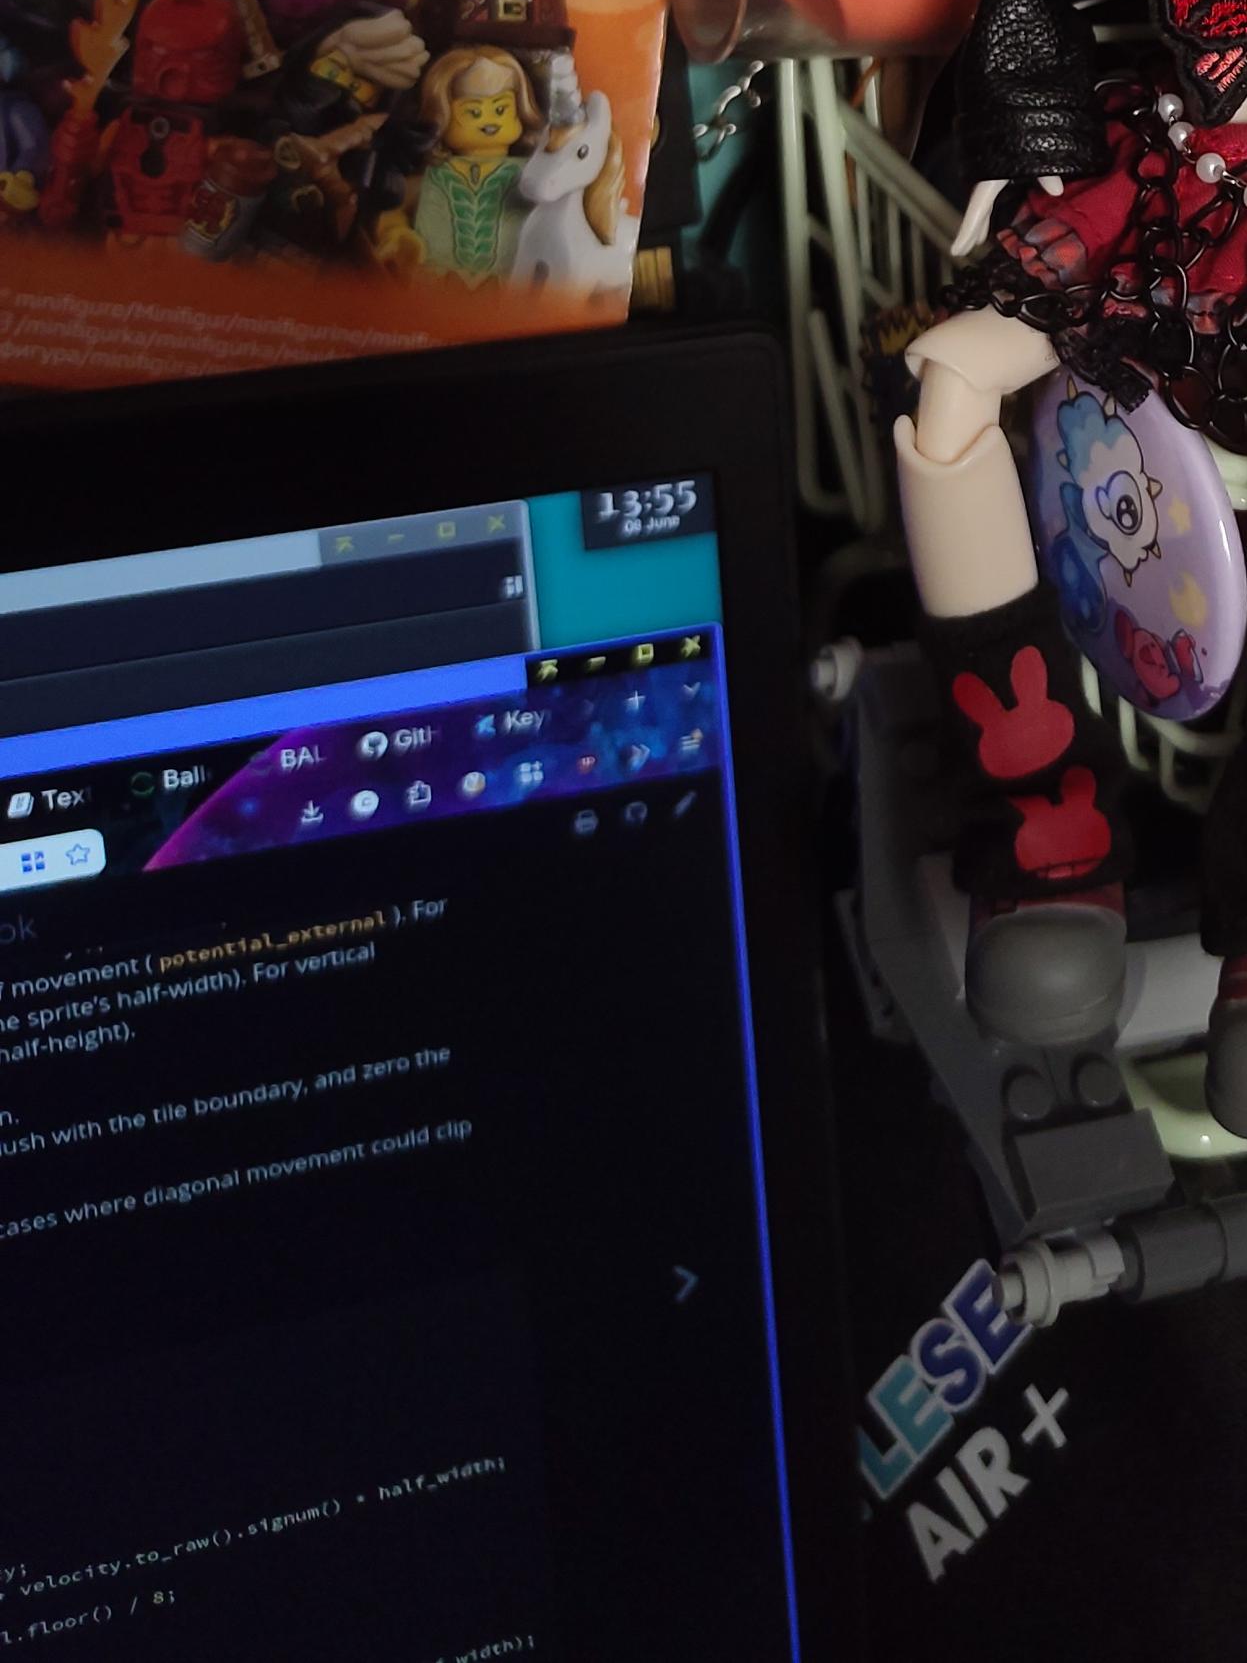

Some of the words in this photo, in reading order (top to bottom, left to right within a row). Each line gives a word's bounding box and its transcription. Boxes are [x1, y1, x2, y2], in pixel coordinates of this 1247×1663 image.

[598, 480, 697, 522] 13:55
[12, 958, 140, 998] movement
[411, 898, 448, 920] For
[27, 995, 111, 1030] sprite's
[252, 961, 288, 984] For
[294, 942, 377, 974] vertical
[51, 1120, 102, 1146] with
[108, 1112, 147, 1135] the
[152, 1103, 188, 1125] tile
[314, 1066, 357, 1090] and
[362, 1057, 410, 1081] zero
[415, 1045, 451, 1069] the
[63, 1195, 137, 1224] where
[143, 1170, 240, 1206] diagonal
[247, 1144, 366, 1182] movement
[371, 1130, 430, 1155] could
[436, 1117, 473, 1144] clip
